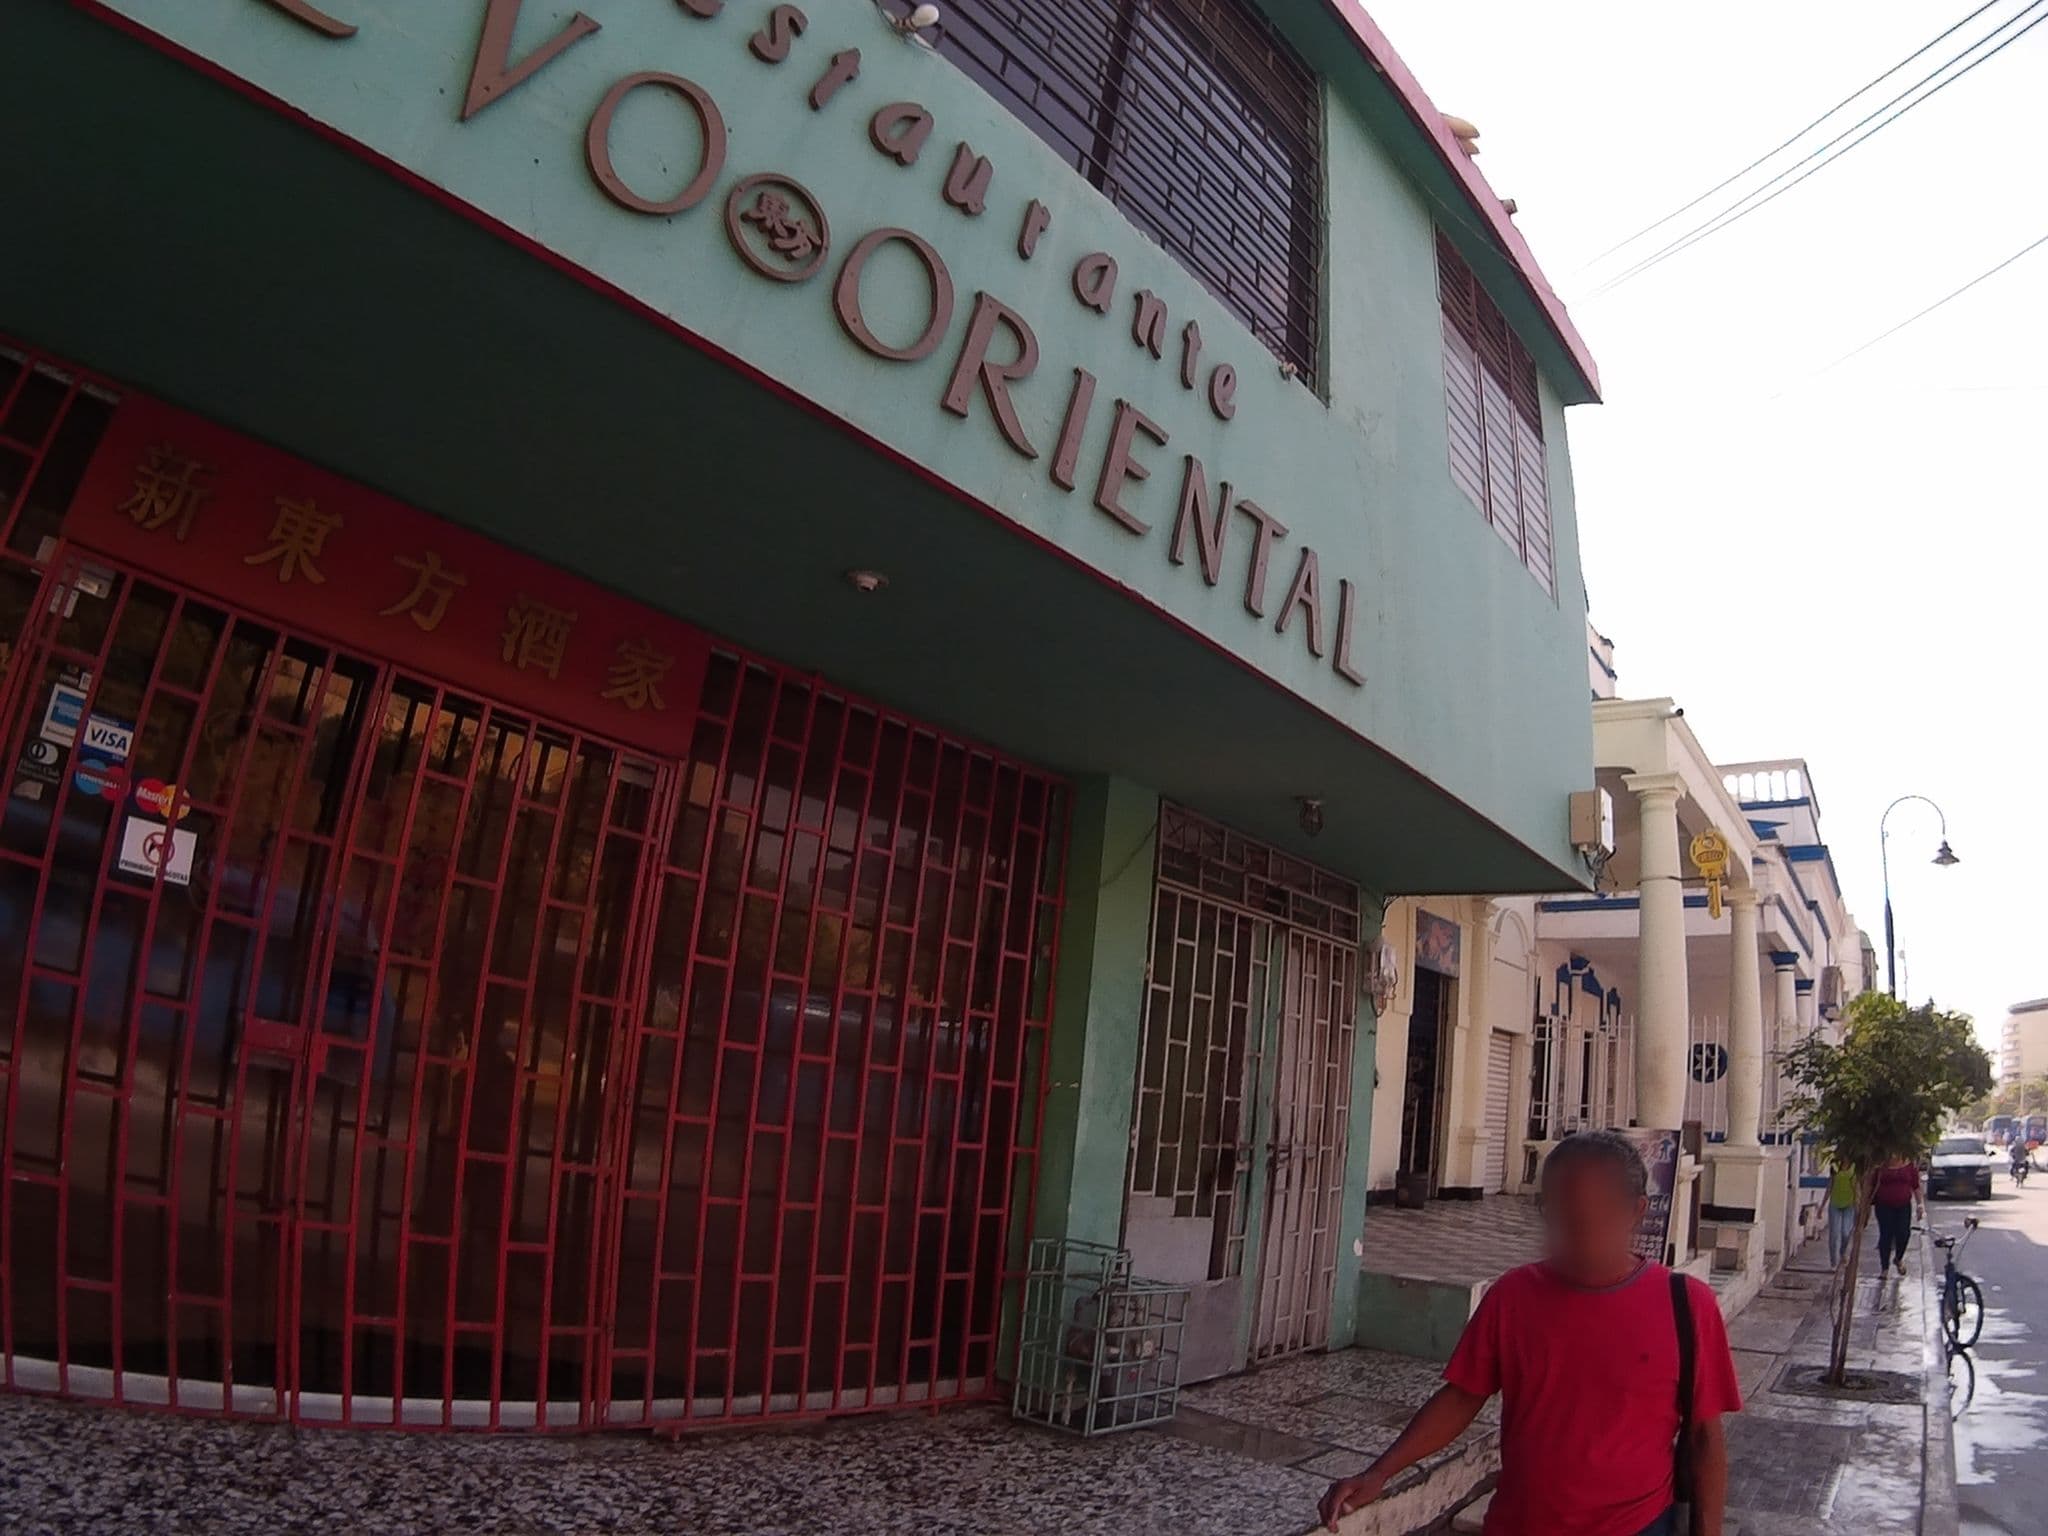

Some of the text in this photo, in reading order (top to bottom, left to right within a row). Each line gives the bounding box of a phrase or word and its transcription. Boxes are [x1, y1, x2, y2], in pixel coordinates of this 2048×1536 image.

[256, 0, 1366, 688] VO ORIENTAL
[90, 727, 127, 752] VISA
